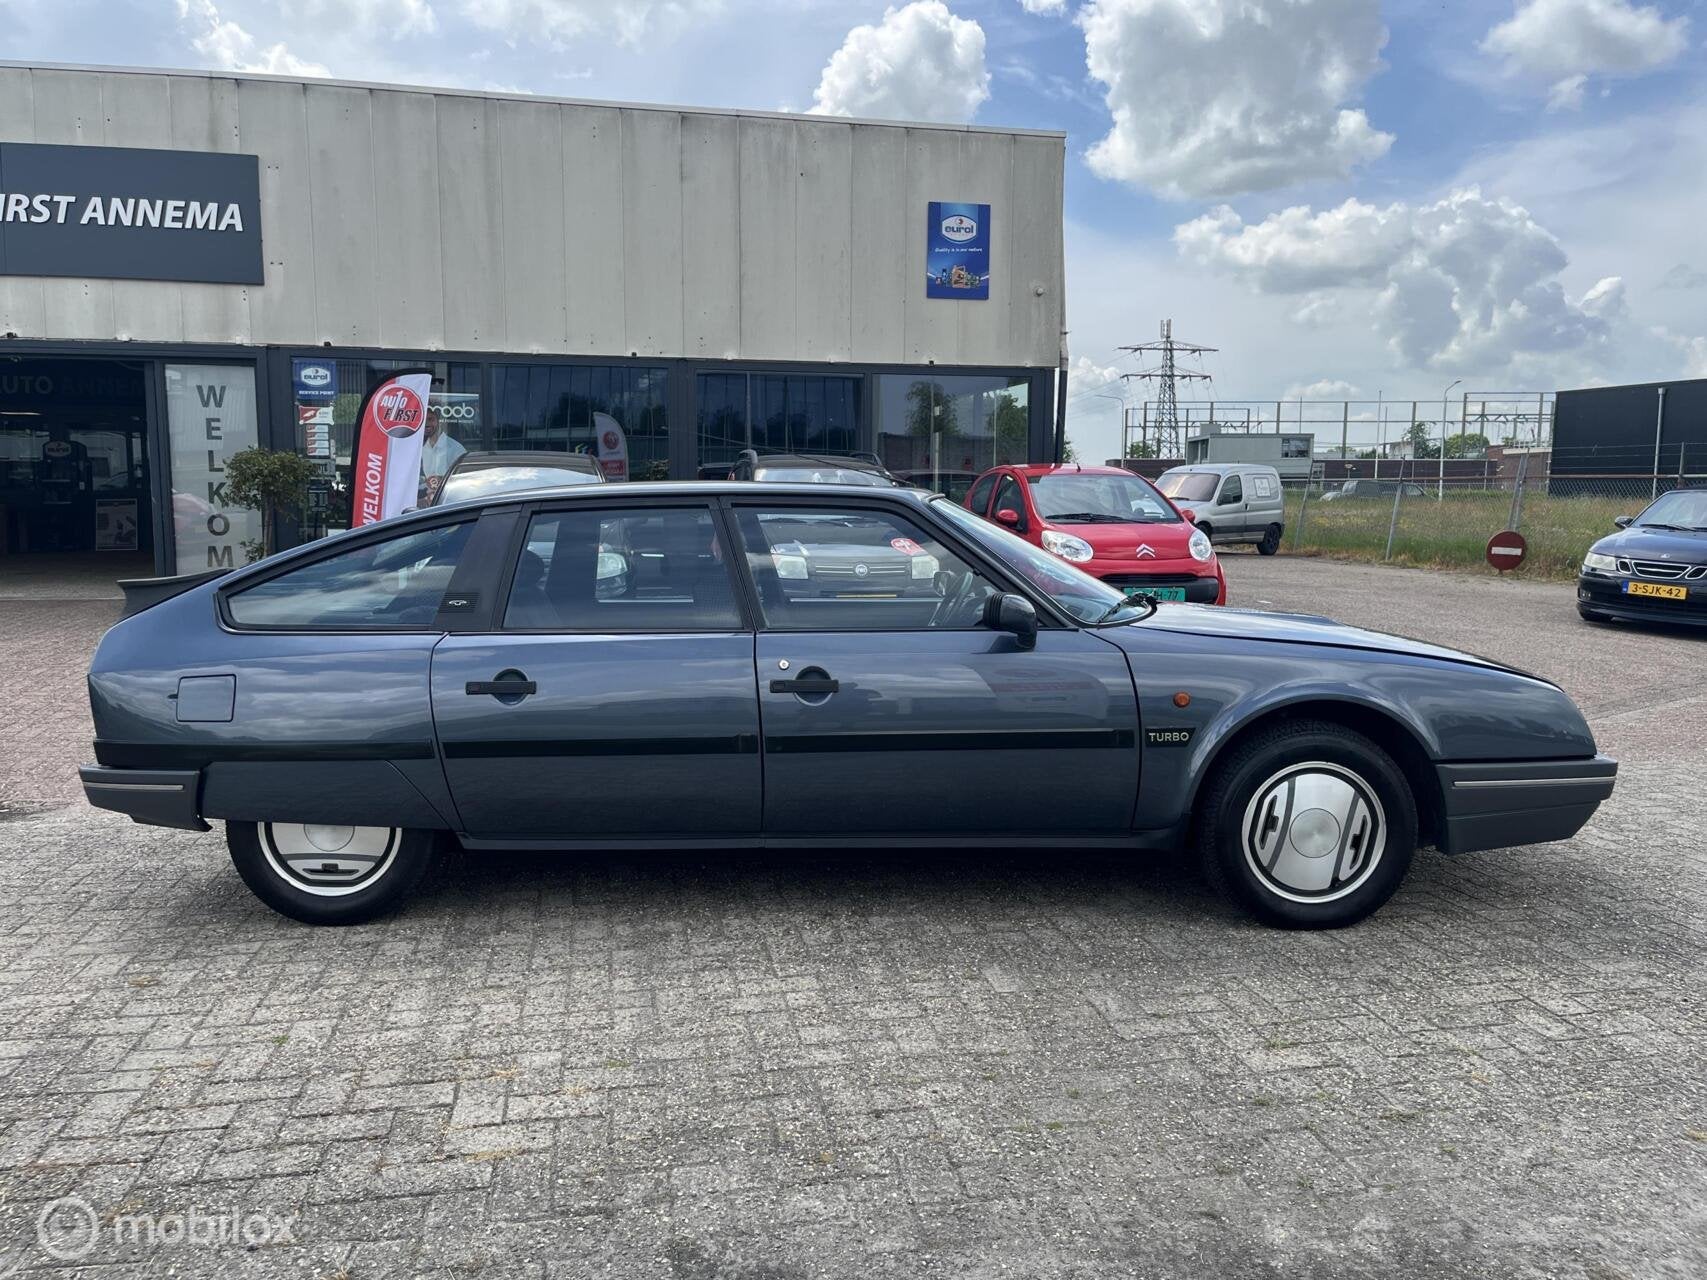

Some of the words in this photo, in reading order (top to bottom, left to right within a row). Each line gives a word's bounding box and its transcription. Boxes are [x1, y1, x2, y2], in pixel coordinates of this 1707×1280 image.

[80, 196, 243, 231] ANNEMA
[945, 225, 974, 233] eurol
[0, 375, 54, 394] UTO
[196, 385, 234, 567] WELKOM
[1631, 584, 1681, 598] 3-SJK-42
[1149, 732, 1189, 741] TURBO
